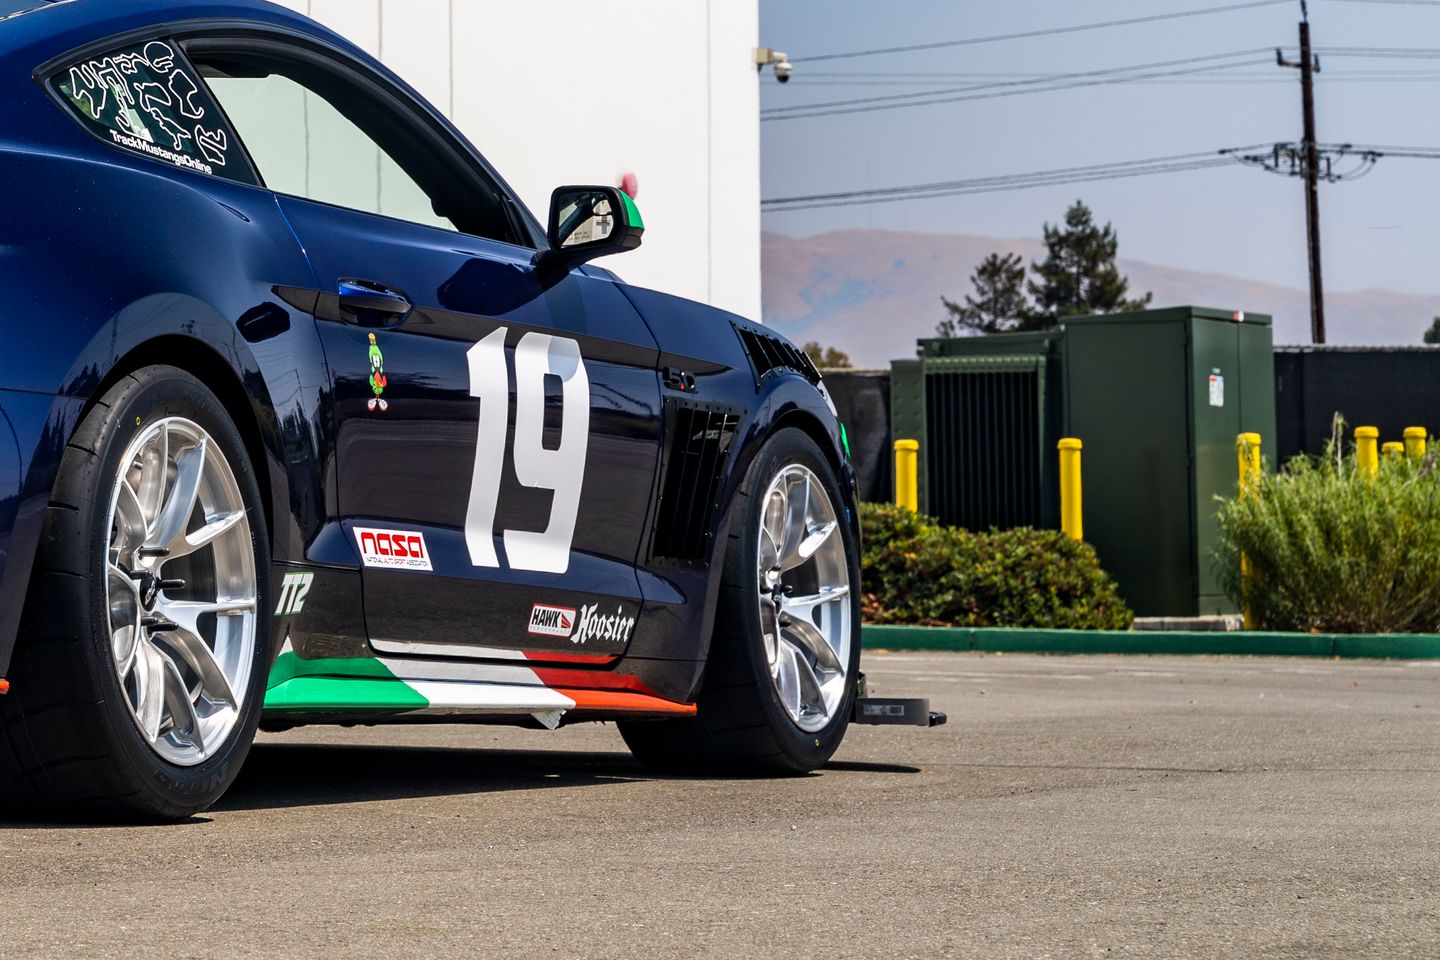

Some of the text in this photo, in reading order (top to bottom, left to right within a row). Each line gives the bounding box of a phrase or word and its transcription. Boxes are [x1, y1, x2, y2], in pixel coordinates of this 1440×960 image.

[109, 128, 213, 175] TrackMustangsOnline
[464, 326, 590, 574] 19
[273, 571, 315, 616] TT2
[531, 608, 562, 628] HAWK
[570, 602, 635, 644] Hoosier
